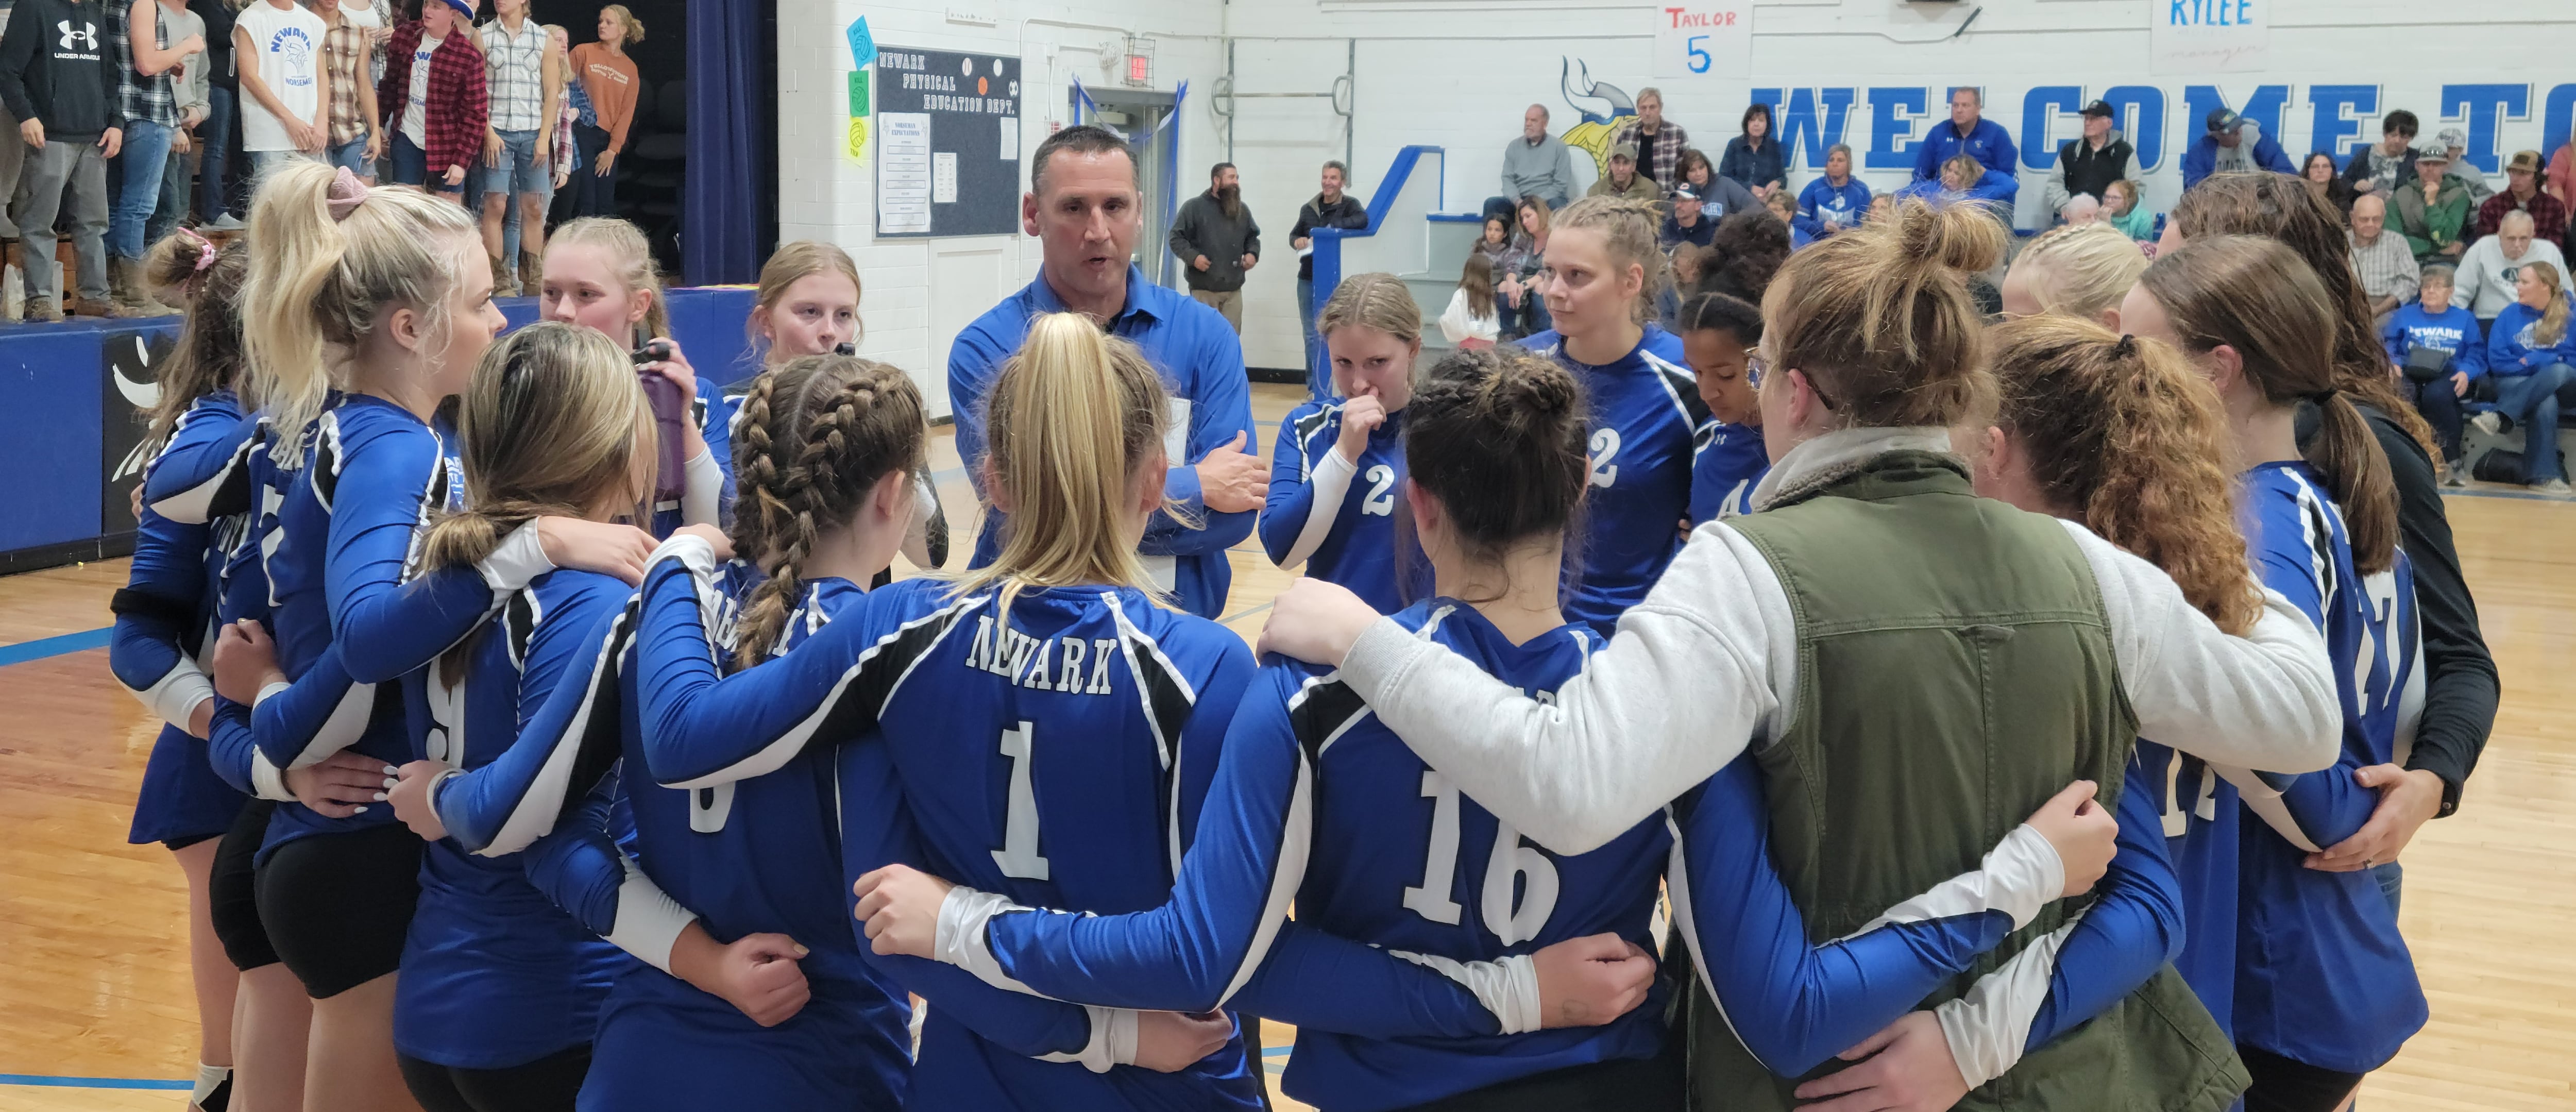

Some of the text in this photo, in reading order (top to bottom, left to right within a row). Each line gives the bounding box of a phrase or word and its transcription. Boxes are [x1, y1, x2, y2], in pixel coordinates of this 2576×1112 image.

[1665, 7, 1737, 28] TAYLOR
[2170, 0, 2253, 26] RYLEE
[879, 52, 925, 70] NEWARK
[1687, 35, 1712, 74] 5
[903, 73, 956, 91] PHYSICAL
[923, 94, 1015, 114] EDUCATION DEPT.
[1751, 85, 2382, 175] WECOME
[1362, 464, 1395, 516] 2
[965, 615, 1118, 695] NEWARK
[991, 720, 1049, 881] 1
[1402, 770, 1560, 948] 16
